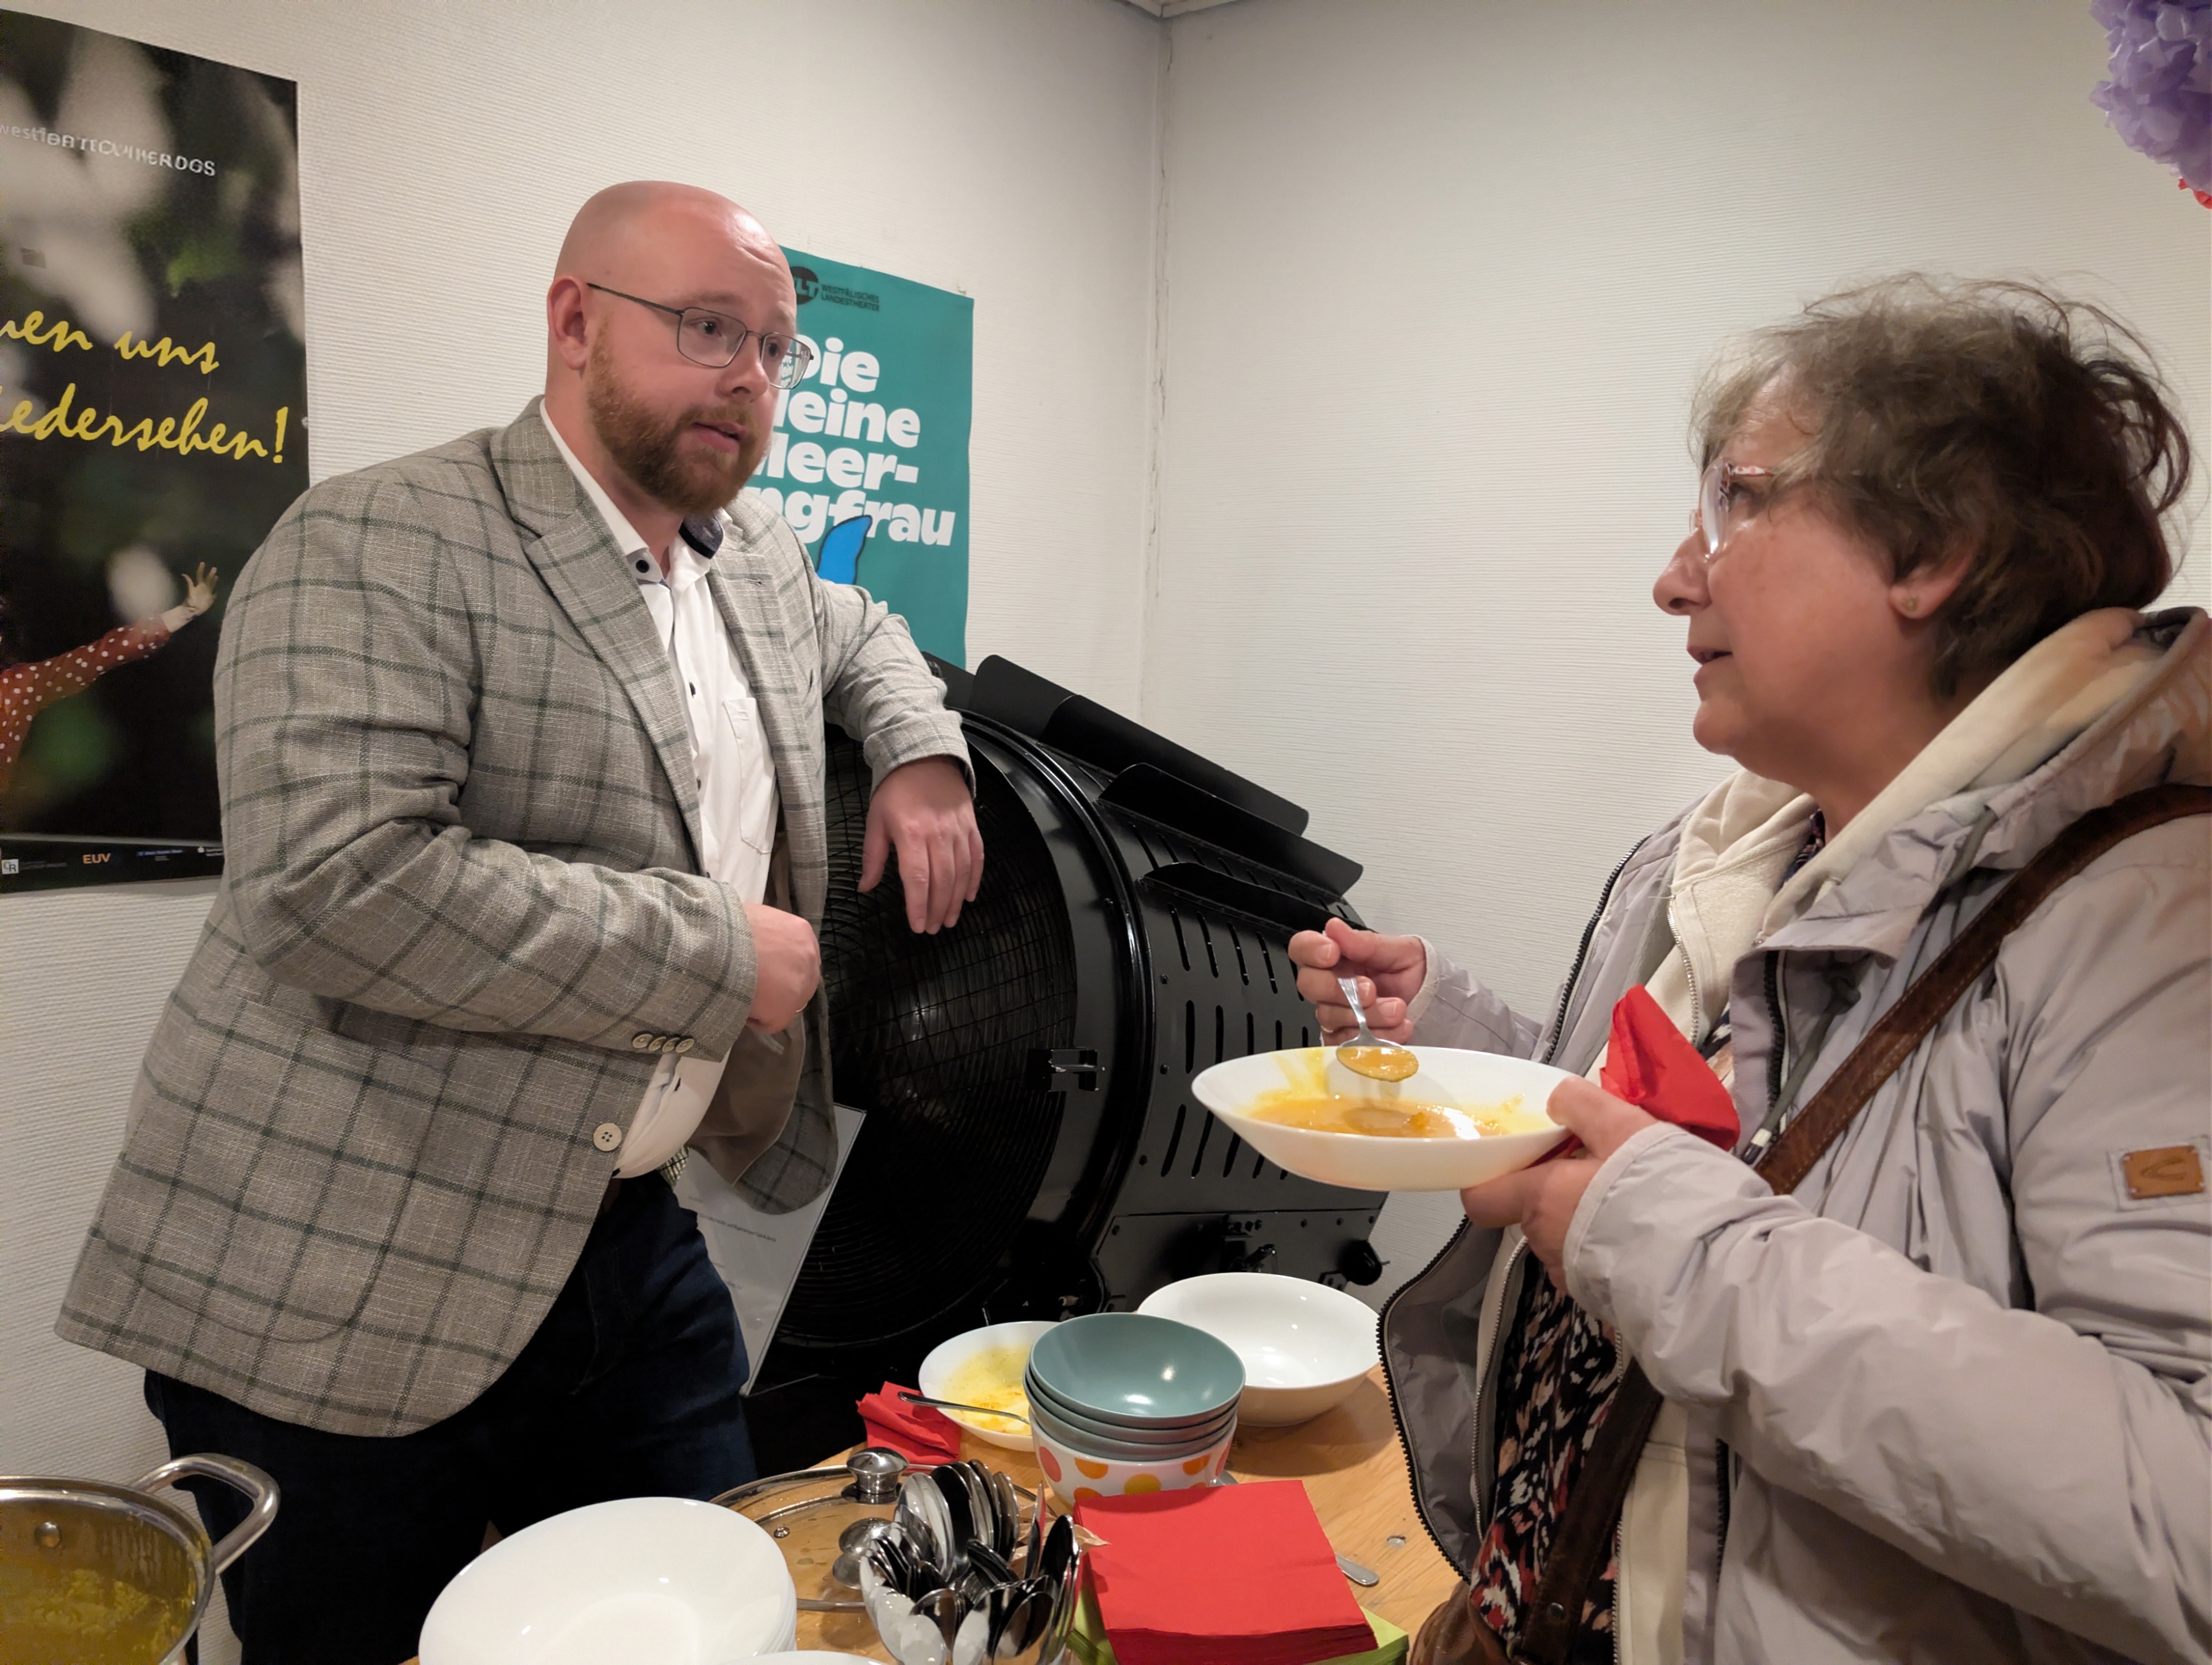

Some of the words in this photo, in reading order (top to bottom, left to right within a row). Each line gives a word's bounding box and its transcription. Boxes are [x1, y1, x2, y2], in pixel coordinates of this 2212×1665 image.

[794, 277, 819, 297] LT
[114, 331, 220, 374] uns
[0, 383, 288, 463] edersehen!
[773, 388, 921, 448] leine
[744, 486, 956, 546] ngfrau
[82, 853, 111, 864] EUV
